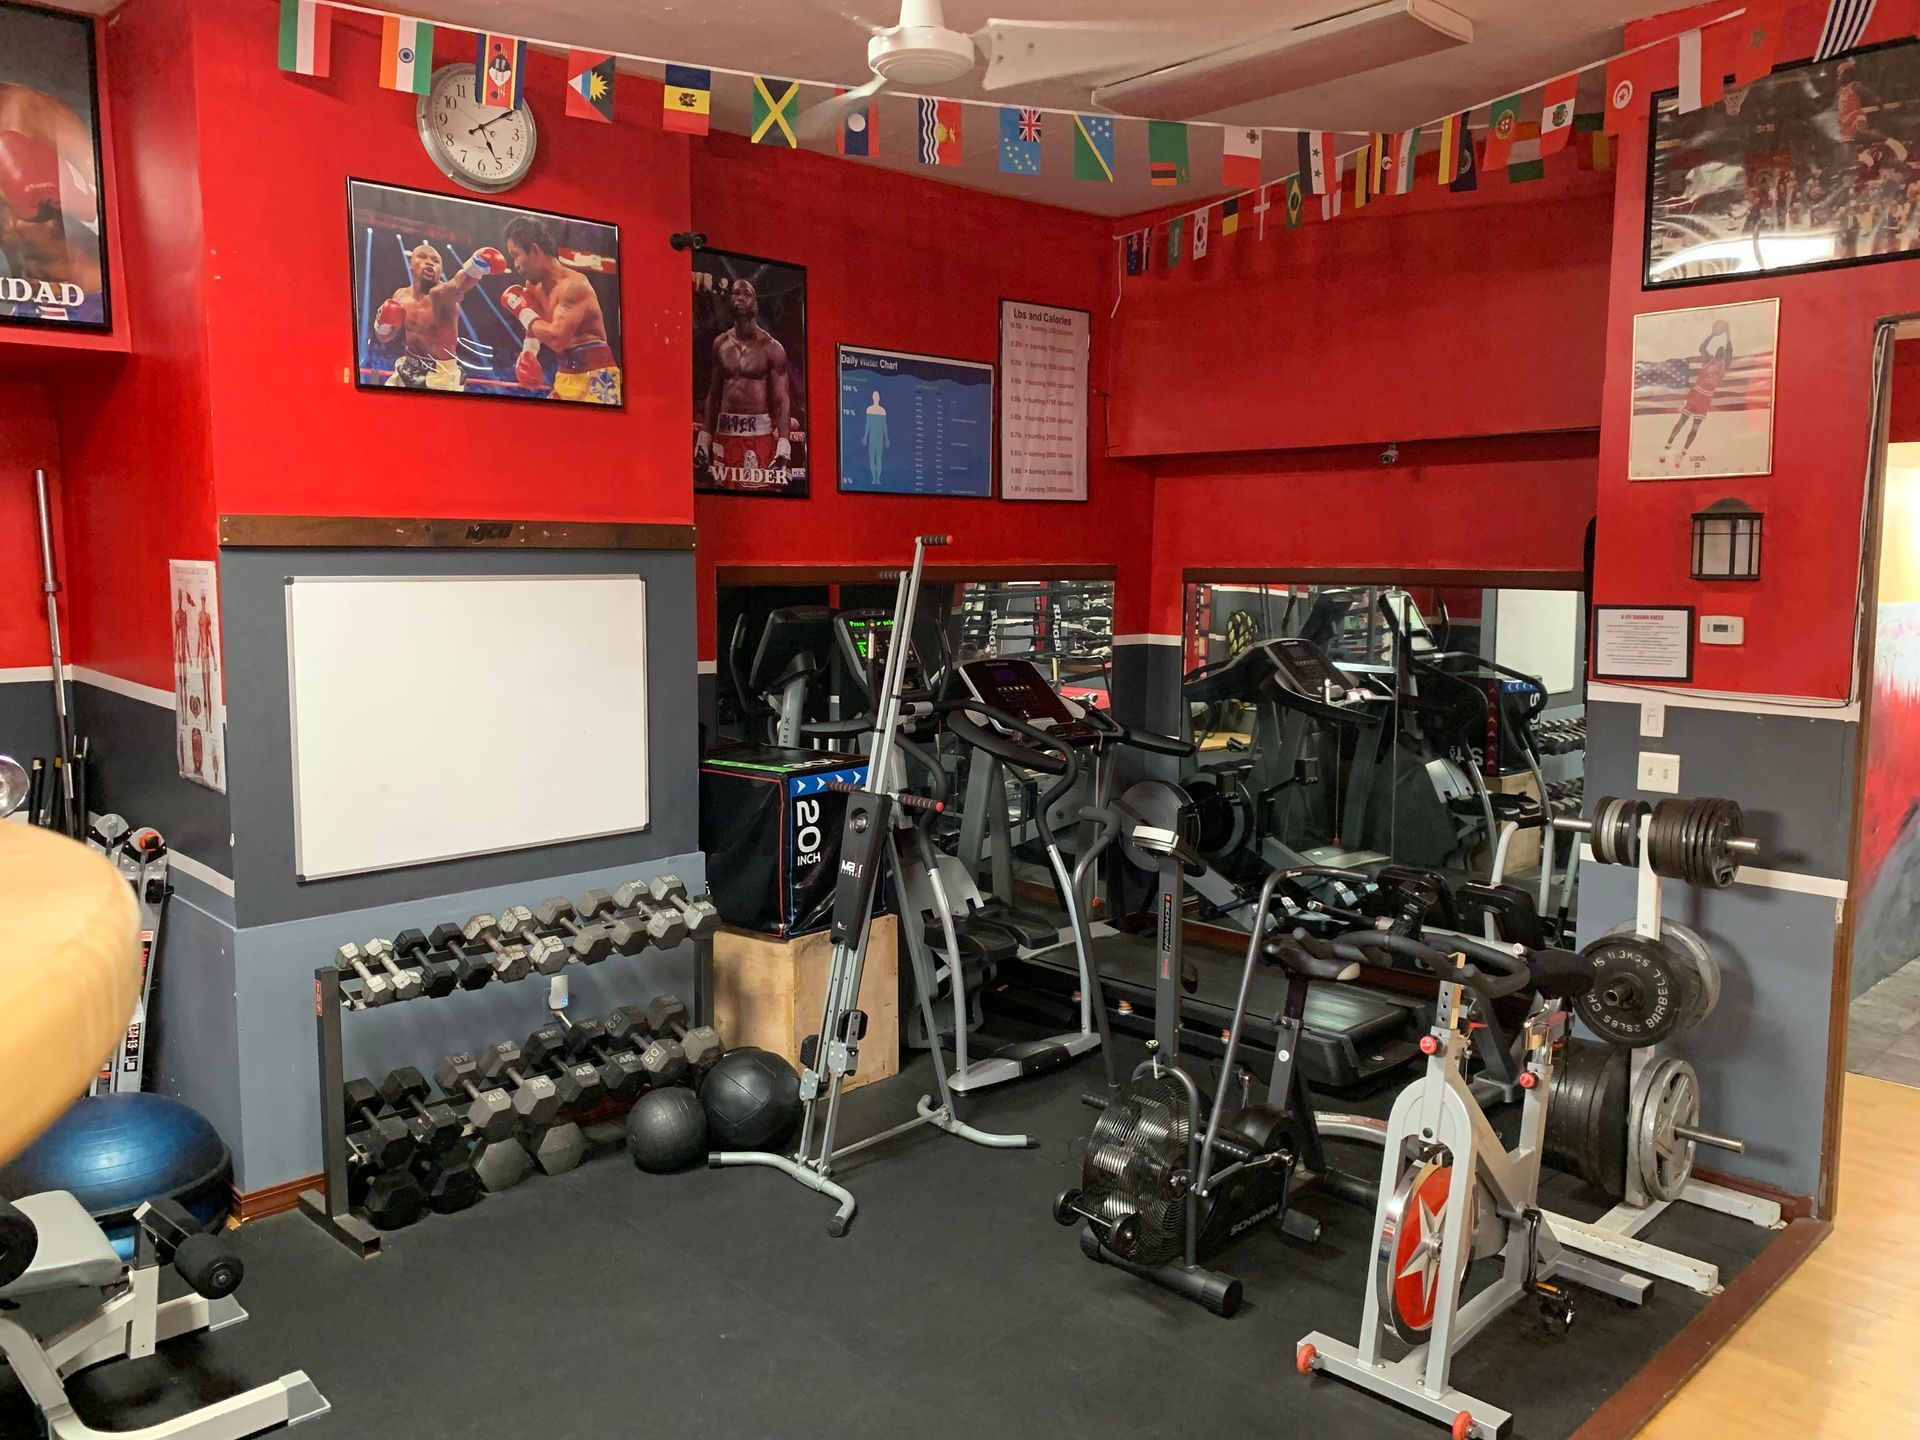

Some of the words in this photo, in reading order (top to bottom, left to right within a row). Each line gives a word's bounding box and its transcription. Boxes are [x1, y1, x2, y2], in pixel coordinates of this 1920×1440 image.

[456, 84, 466, 98] 11
[445, 96, 457, 110] 10
[440, 113, 448, 125] 9
[445, 133, 454, 147] 8
[512, 128, 520, 141] 3
[460, 150, 468, 163] 7
[506, 146, 514, 159] 4
[477, 159, 486, 172] 6
[495, 158, 503, 170] 5
[1014, 308, 1027, 319] Lbs
[1028, 311, 1042, 321] and
[1043, 313, 1072, 326] Calories
[841, 354, 858, 367] Daily
[860, 358, 878, 367] Water
[880, 359, 898, 370] Chart
[708, 465, 788, 485] WILDER
[1053, 604, 1061, 652] RINGSI
[796, 799, 822, 854] 20
[797, 851, 821, 866] INCH
[1645, 969, 1668, 1029] BARBELL
[1604, 1014, 1642, 1033] 25LBS
[645, 1048, 660, 1064] 50
[575, 1066, 596, 1077] 45
[488, 1092, 503, 1102] 40
